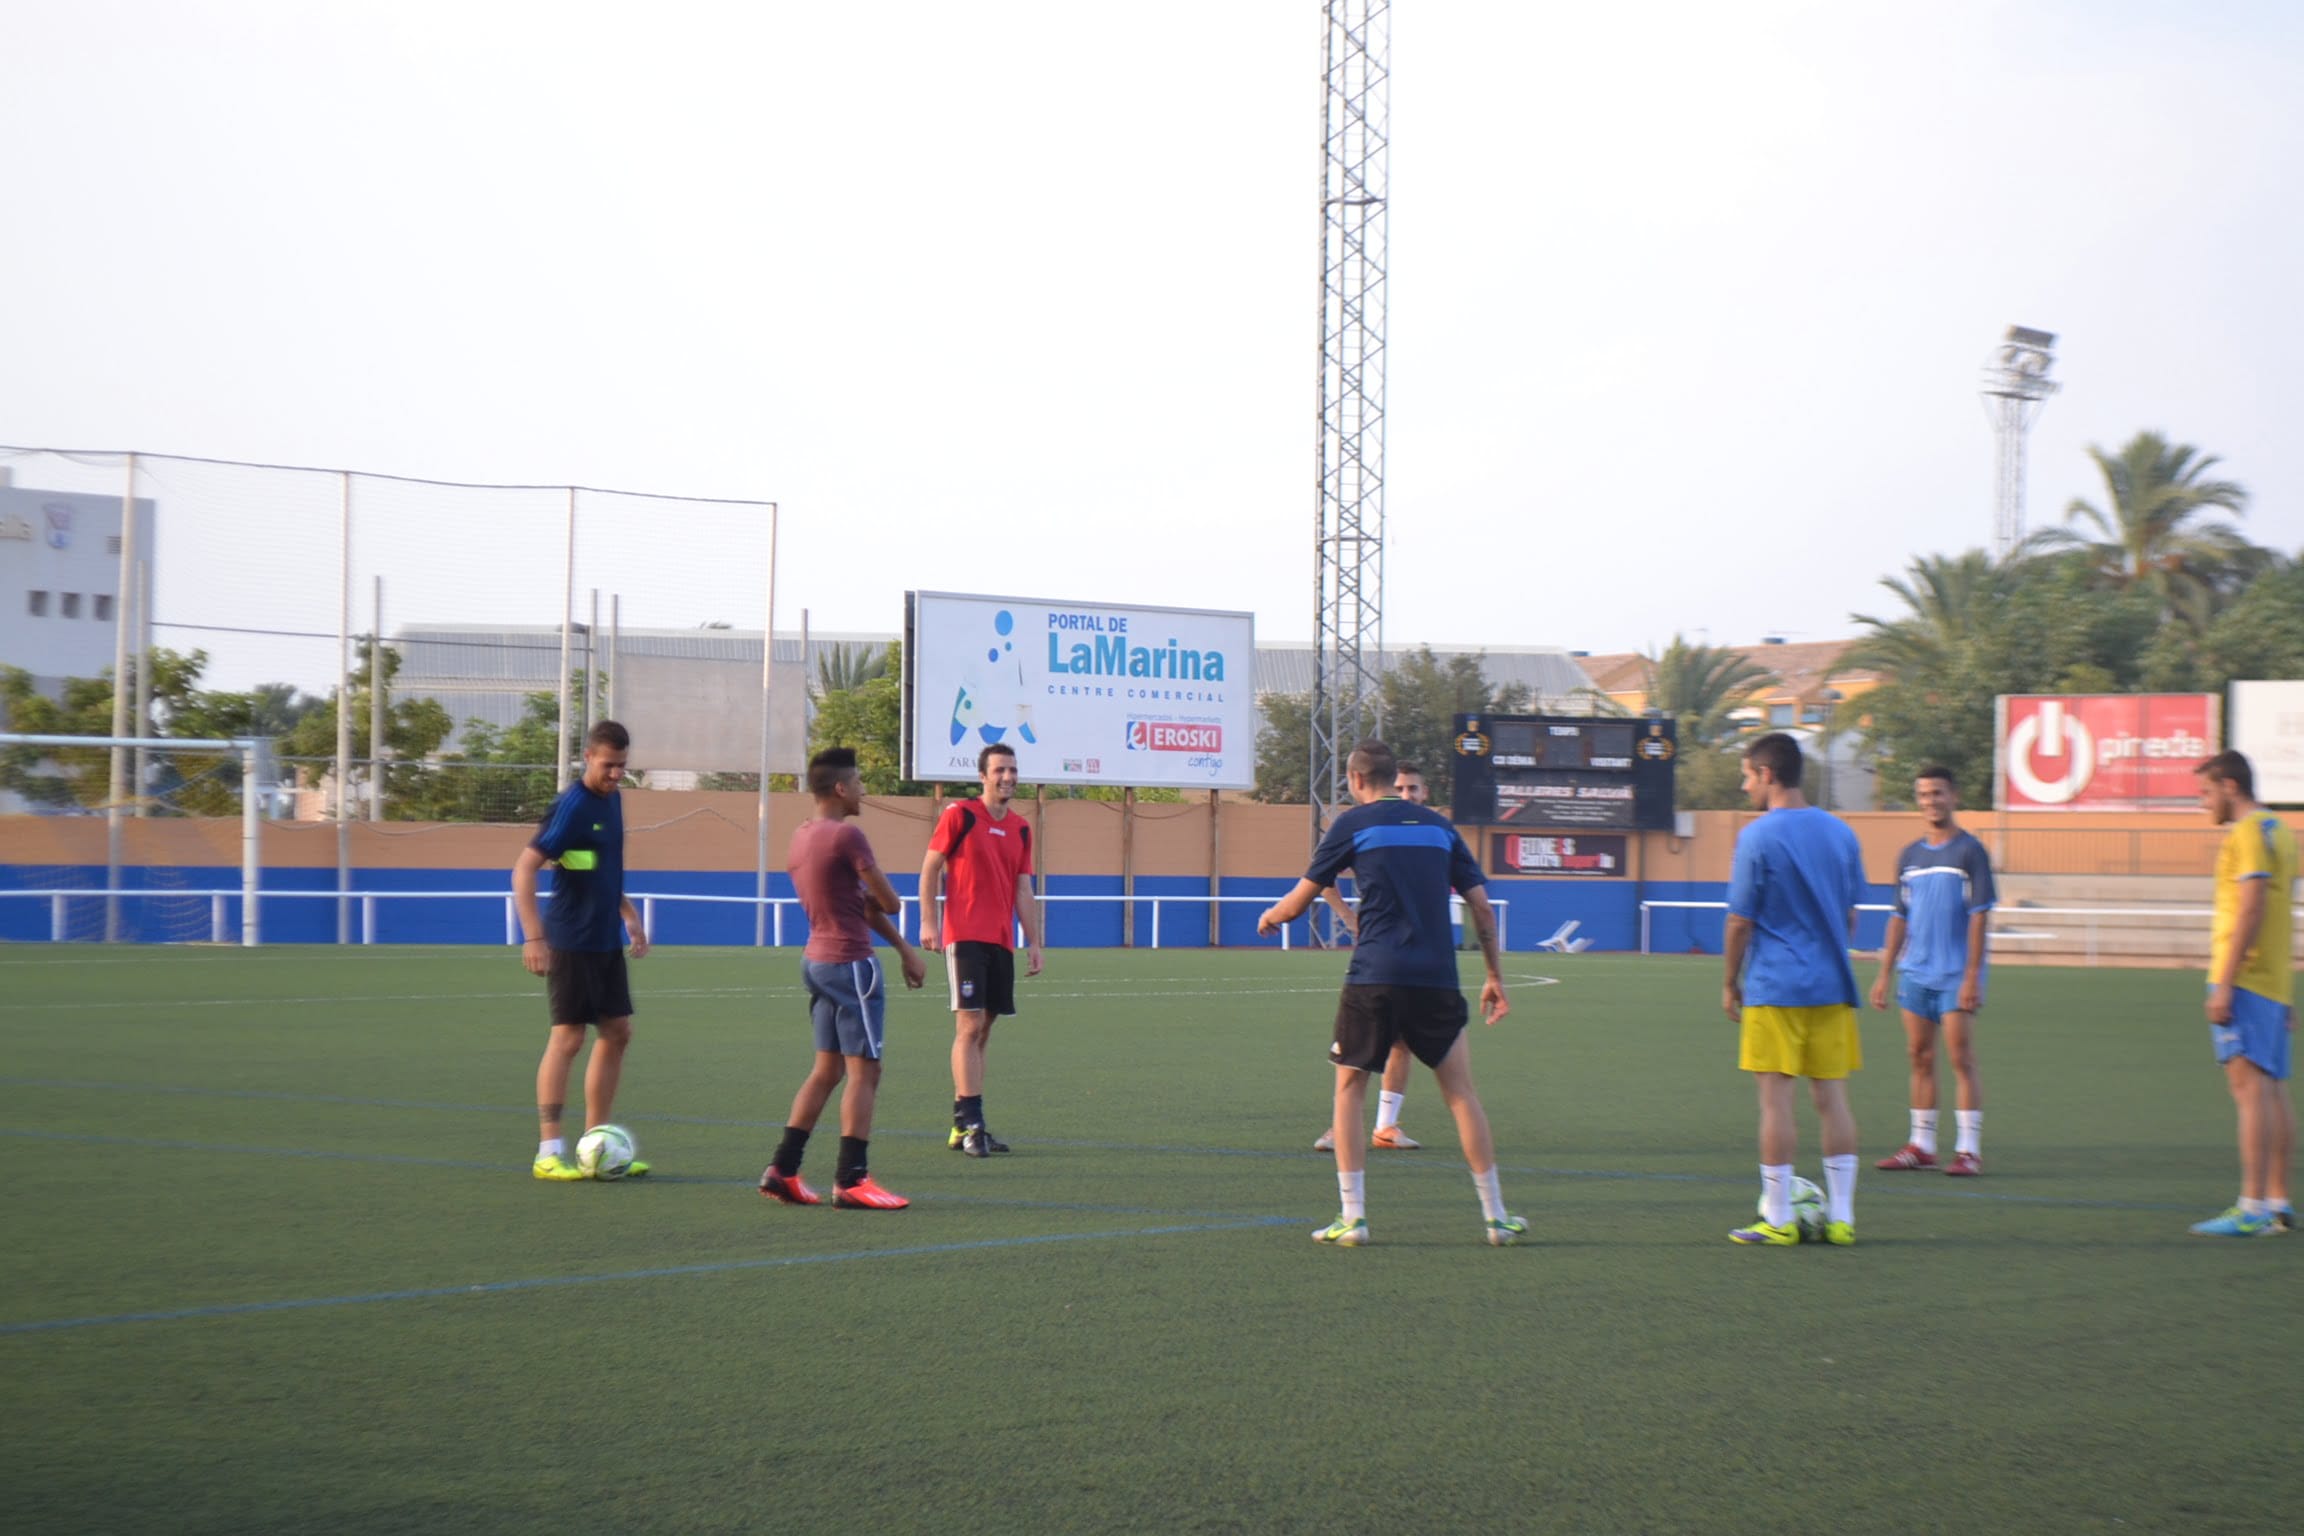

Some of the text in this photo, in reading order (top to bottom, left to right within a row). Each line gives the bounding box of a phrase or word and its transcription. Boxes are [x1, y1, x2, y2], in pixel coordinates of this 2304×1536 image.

[1049, 613, 1127, 632] PORTAL DE
[1048, 632, 1224, 681] LaMarina
[1048, 685, 1224, 702] CENTRE COMERCIAL
[1154, 727, 1217, 748] EROSKI
